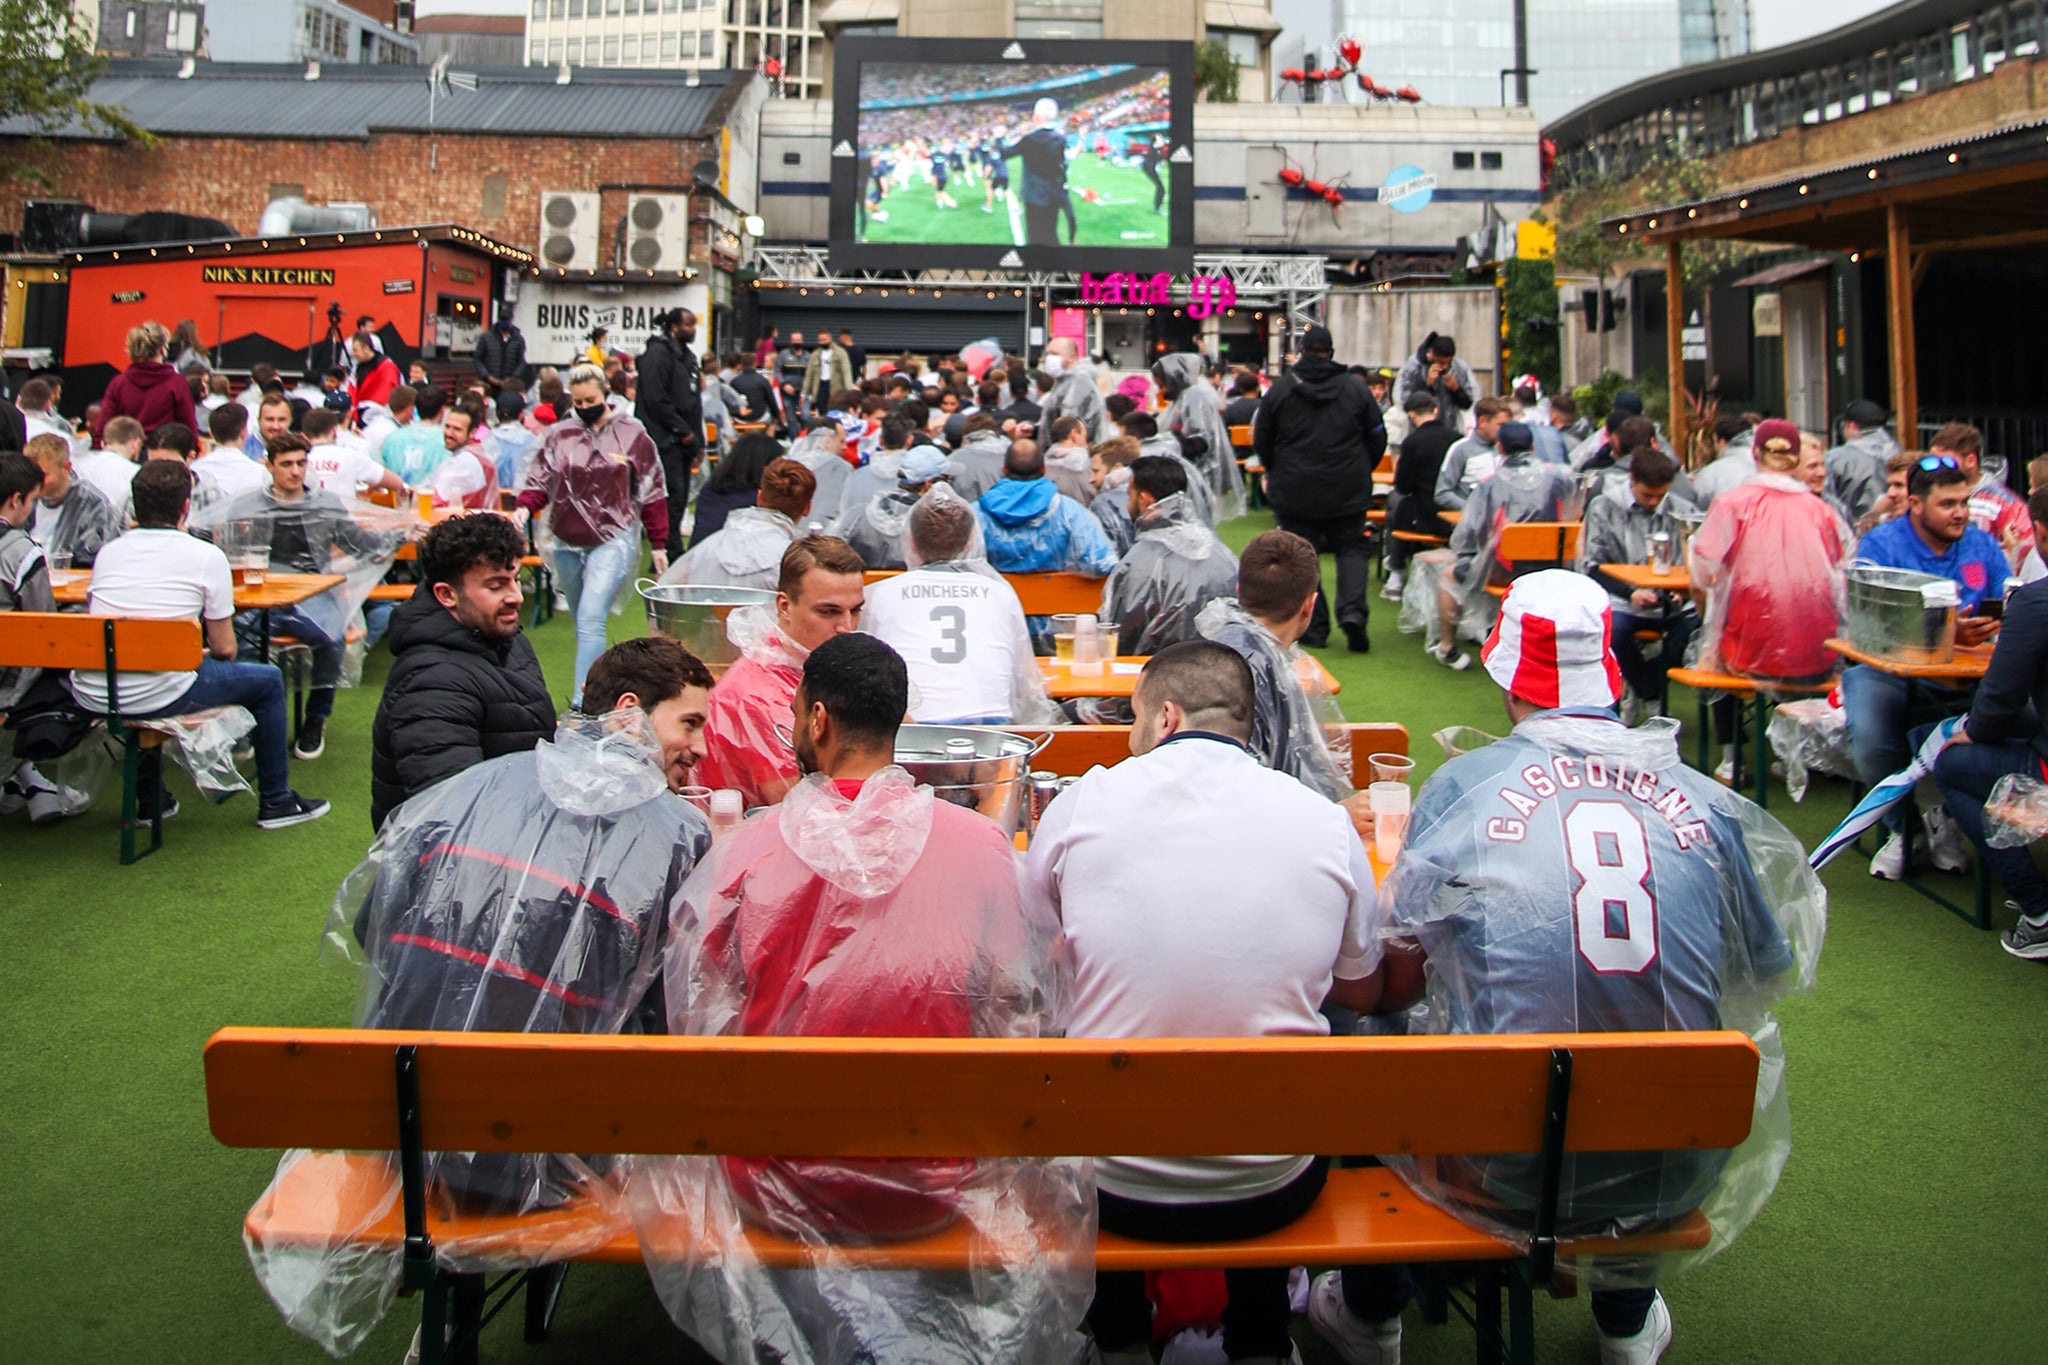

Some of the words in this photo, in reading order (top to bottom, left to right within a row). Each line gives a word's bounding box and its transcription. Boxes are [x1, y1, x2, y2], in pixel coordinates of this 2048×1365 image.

[204, 267, 247, 282] NIK'S
[251, 269, 334, 284] KITCHEN
[1081, 272, 1171, 304] baba
[537, 304, 589, 329] BUNS
[404, 446, 424, 470] 10
[901, 584, 990, 600] KONCHESKY
[929, 605, 967, 664] 3
[1486, 754, 1710, 851] GASCOIGNE
[1564, 798, 1660, 976] 8
